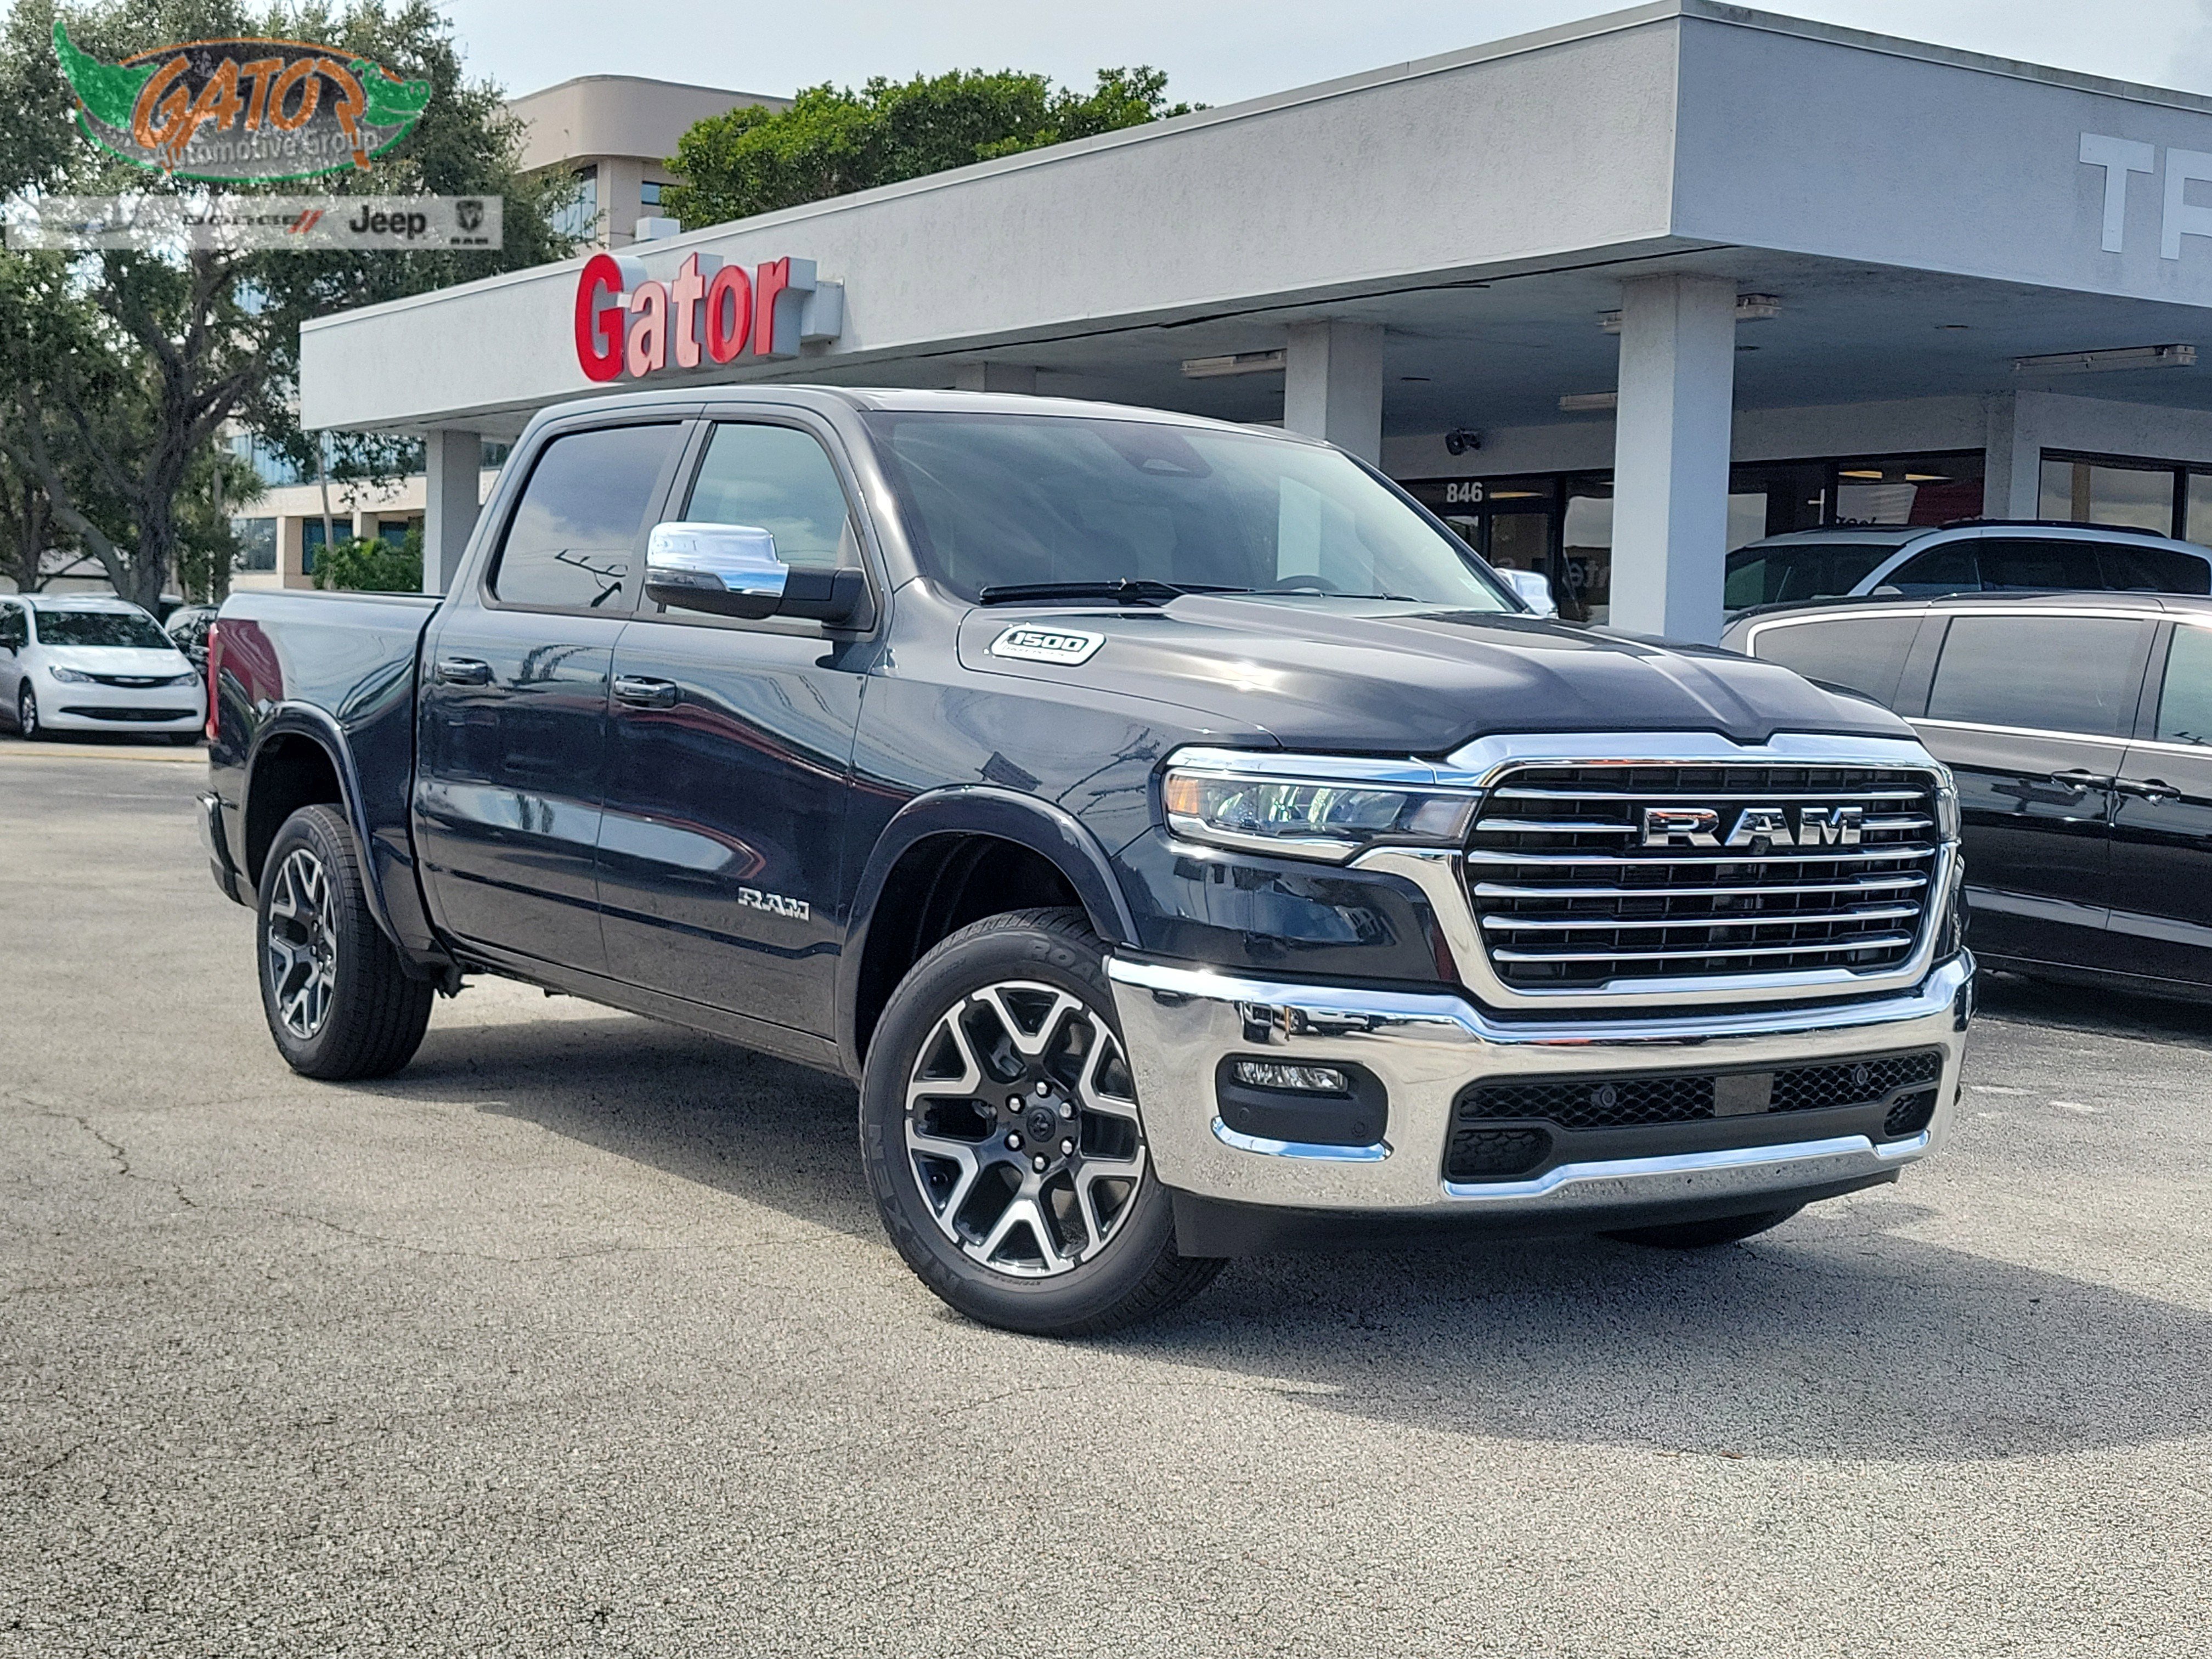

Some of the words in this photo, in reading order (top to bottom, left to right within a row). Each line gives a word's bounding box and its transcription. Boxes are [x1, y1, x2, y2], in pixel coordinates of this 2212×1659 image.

[575, 251, 790, 382] Gator
[1446, 482, 1483, 503] 846
[1015, 631, 1088, 652] 1500
[1643, 807, 1863, 846] RAM
[737, 887, 810, 921] RAM
